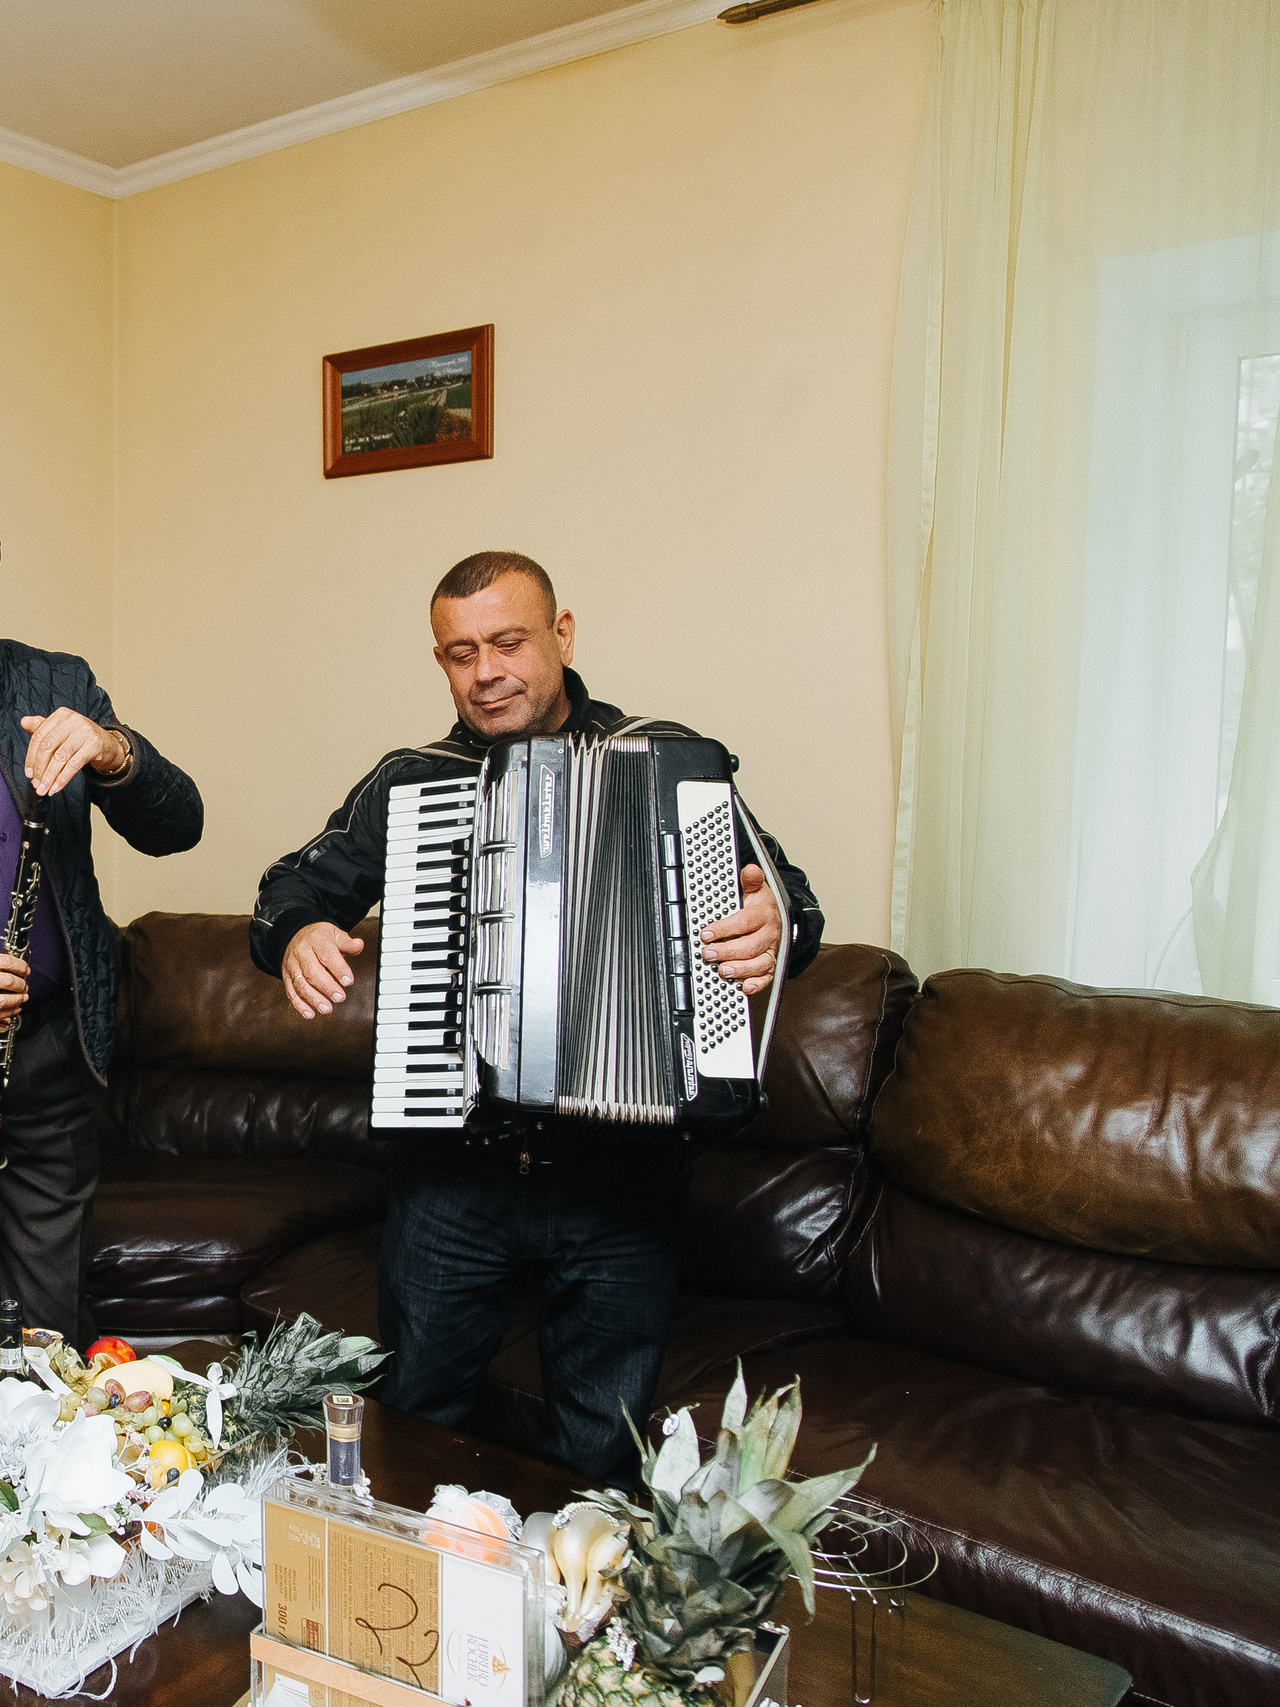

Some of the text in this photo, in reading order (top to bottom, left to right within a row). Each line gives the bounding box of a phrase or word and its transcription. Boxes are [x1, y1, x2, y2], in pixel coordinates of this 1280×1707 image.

[541, 773, 553, 852] weltmeister
[277, 1602, 288, 1625] 300
[467, 1633, 478, 1682] ROCHER
[478, 1637, 489, 1687] FERRERO
